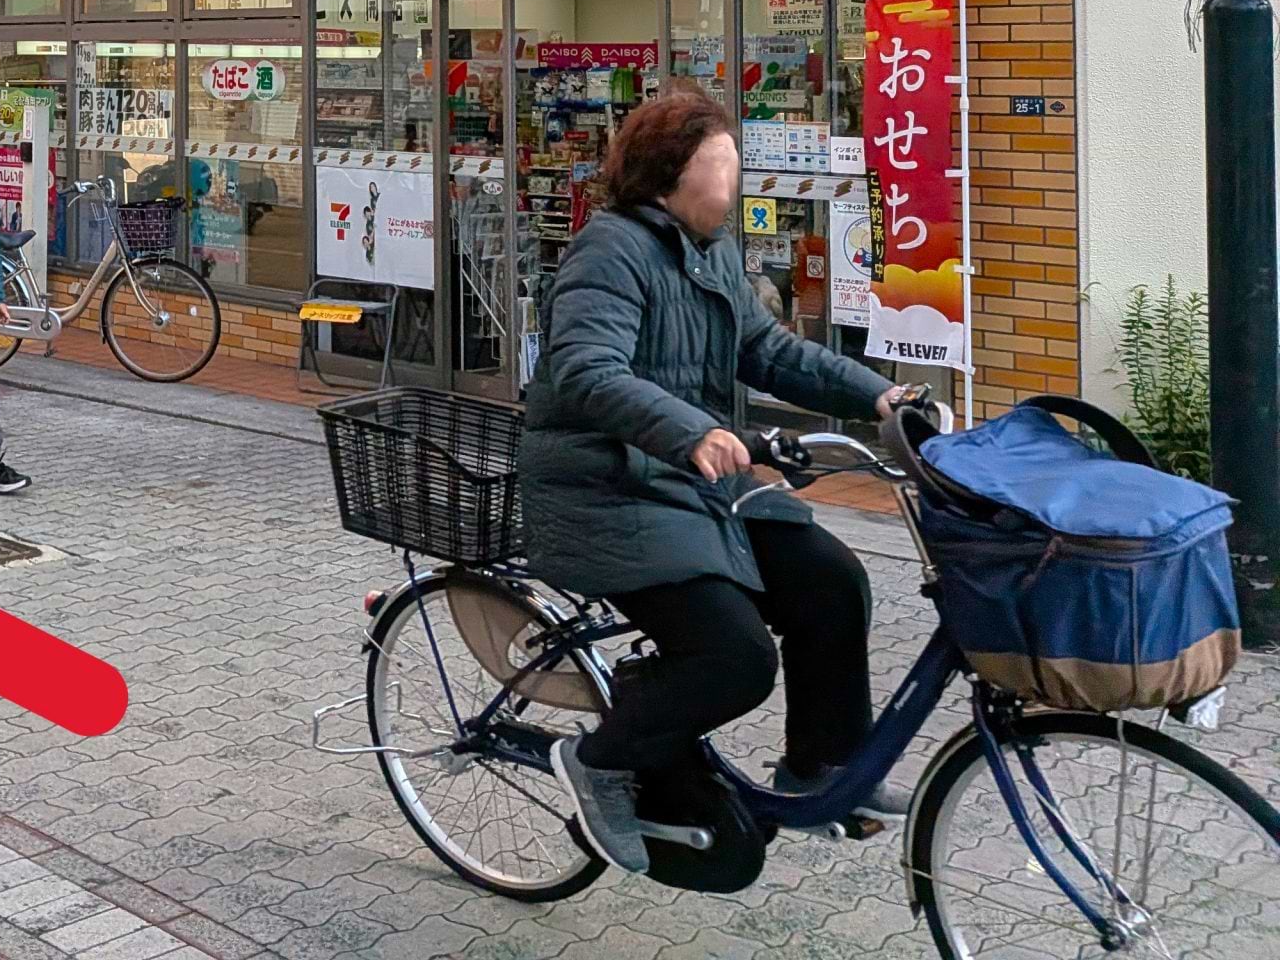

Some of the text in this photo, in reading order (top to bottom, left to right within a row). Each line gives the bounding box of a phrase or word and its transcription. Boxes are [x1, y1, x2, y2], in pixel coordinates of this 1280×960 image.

[541, 48, 640, 57] DAISO DAISO
[211, 66, 273, 90] たばこ 酒
[1015, 103, 1040, 113] 25-1
[874, 36, 931, 250] おせち
[870, 171, 885, 280] ご予約承り中
